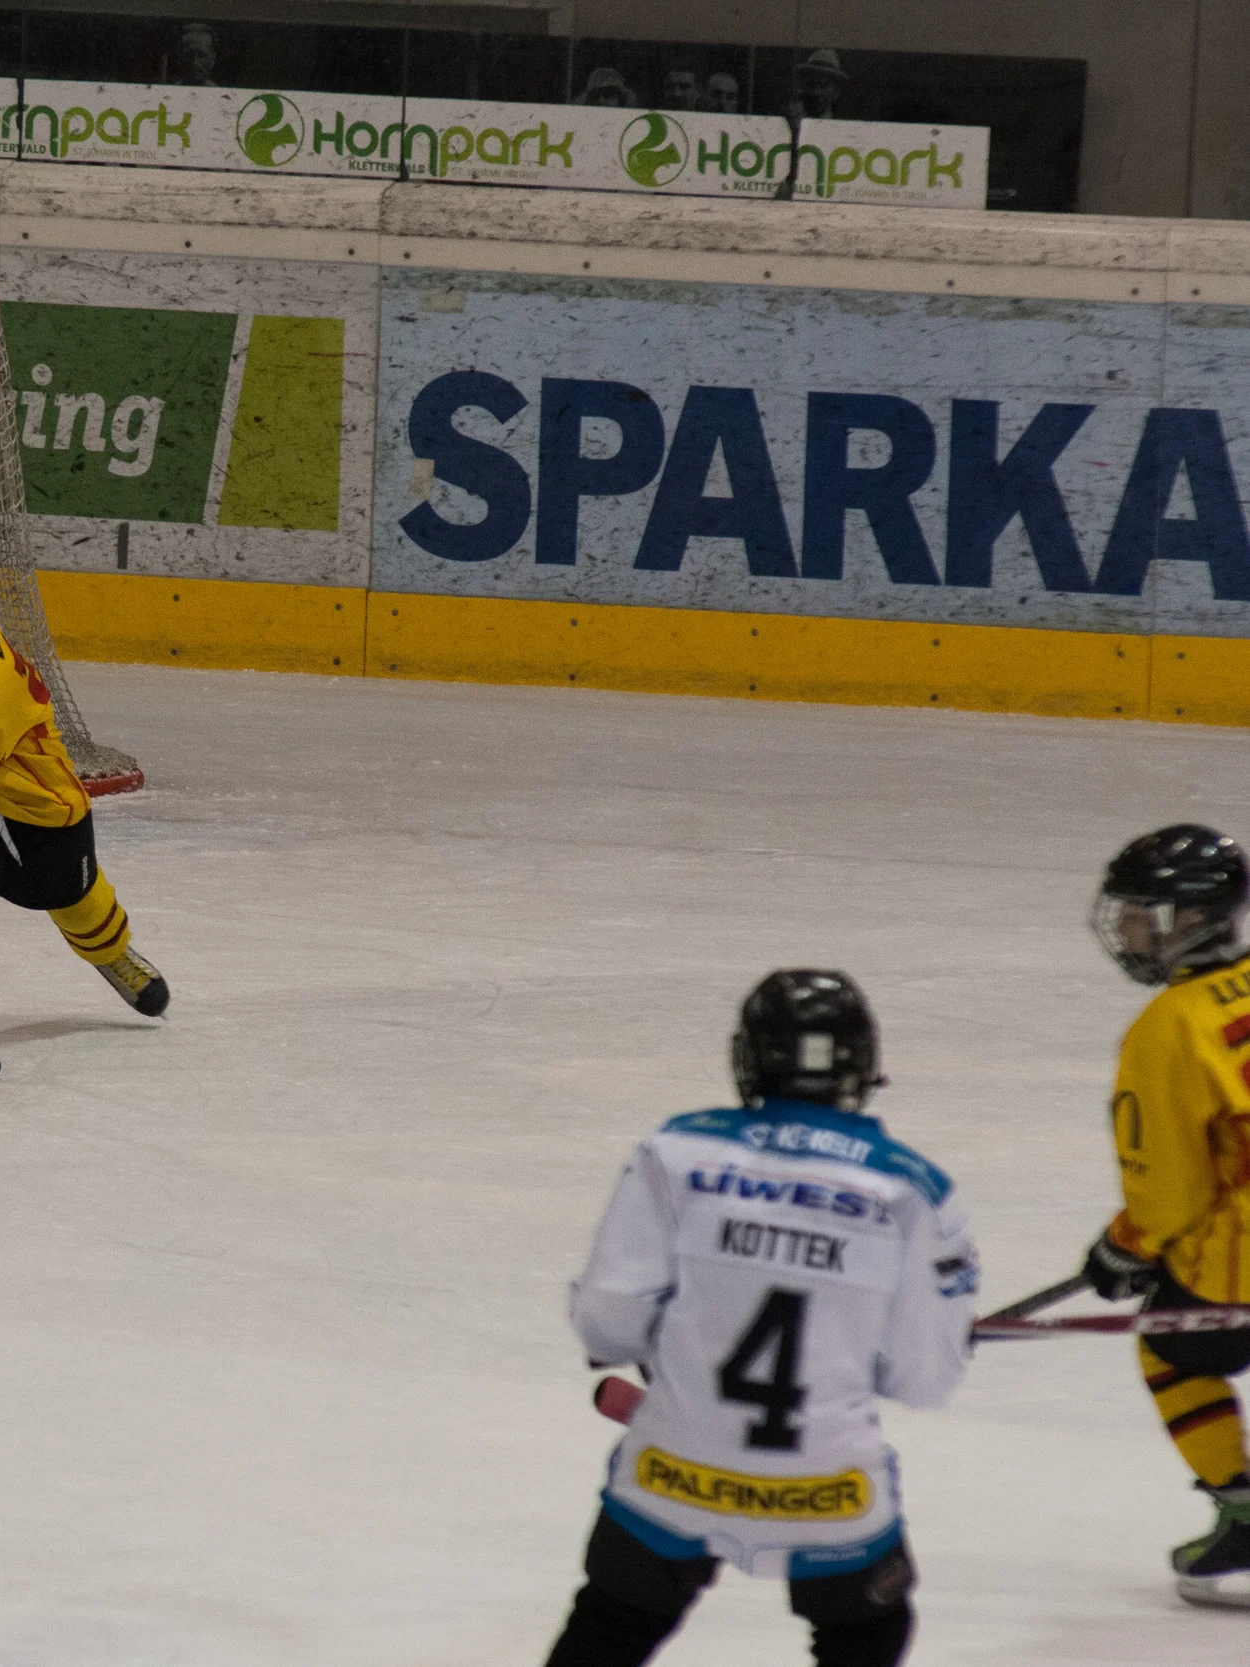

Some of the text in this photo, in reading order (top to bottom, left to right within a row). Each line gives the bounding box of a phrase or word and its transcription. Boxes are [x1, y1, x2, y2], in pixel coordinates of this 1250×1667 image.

[313, 111, 574, 177] Hornpark
[399, 370, 1250, 600] SPARKA
[721, 1217, 848, 1274] KOTTEK
[720, 1289, 811, 1451] 4
[649, 1456, 863, 1513] PALFINGER
